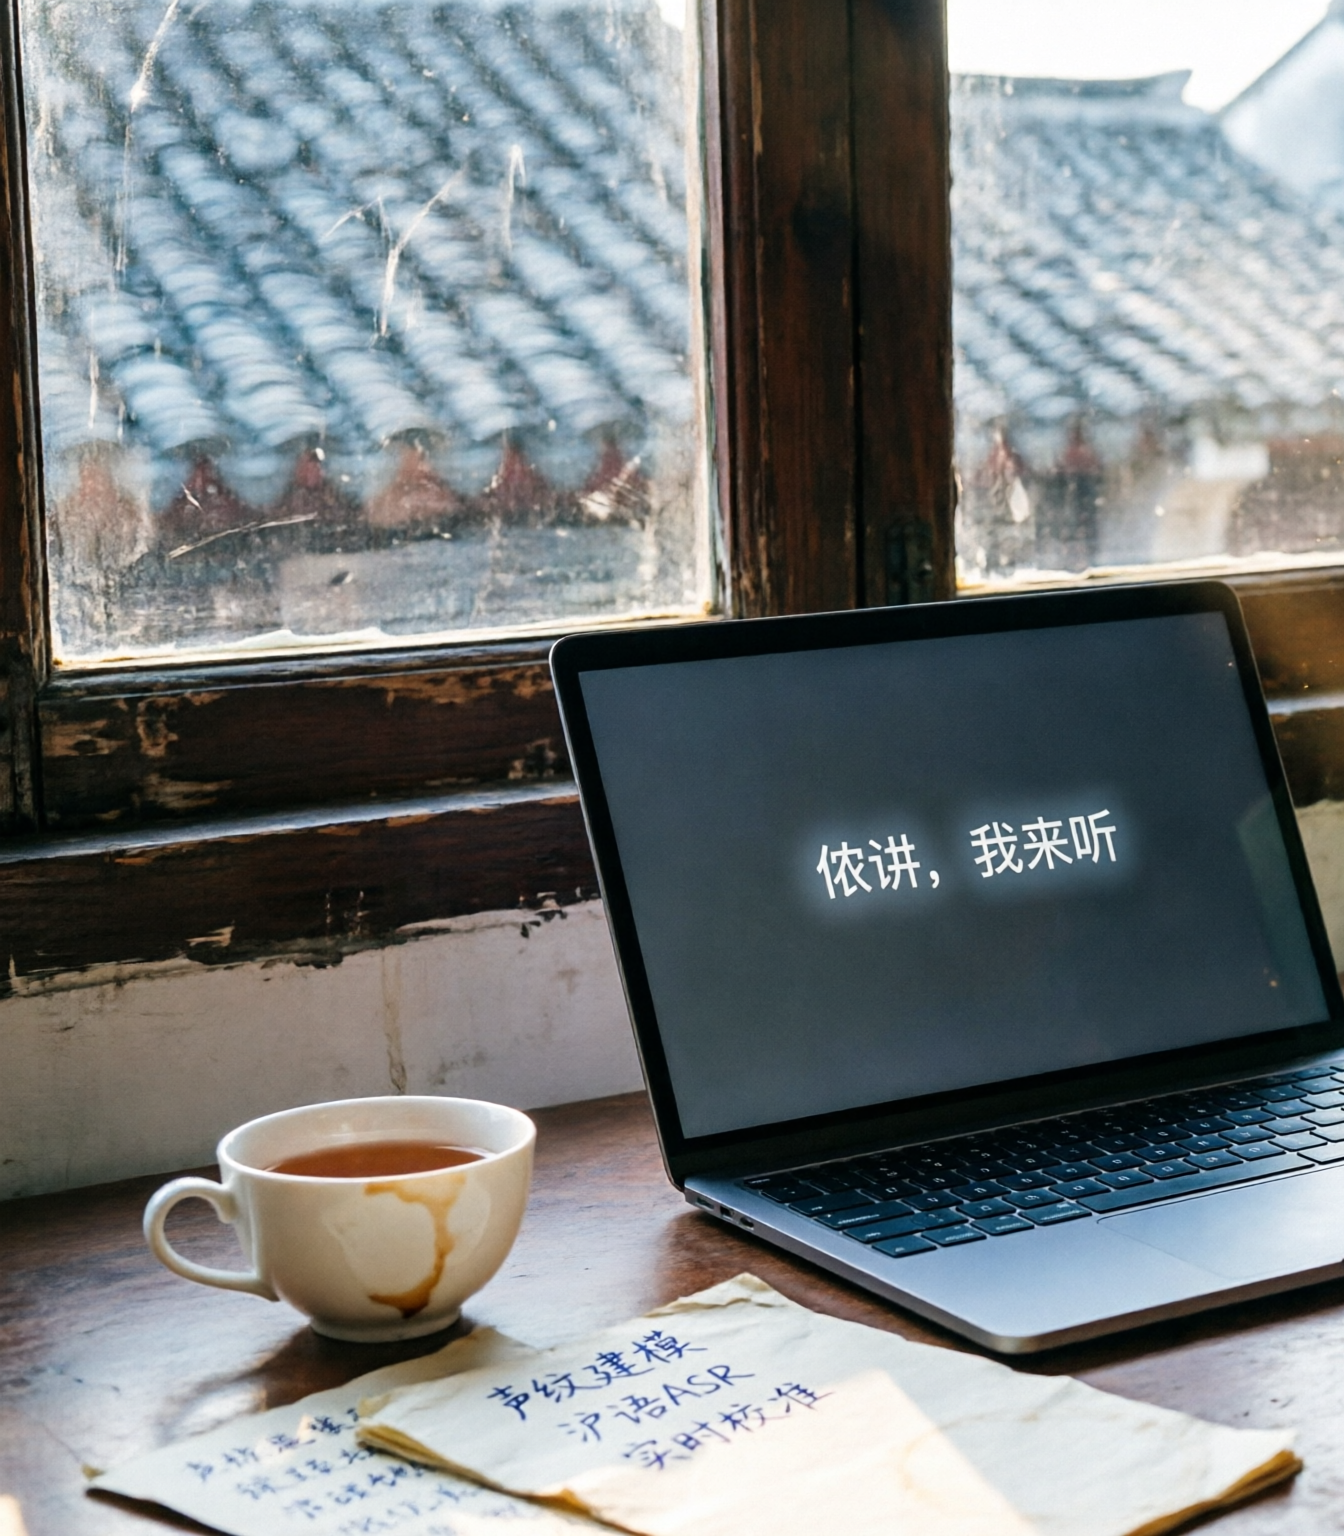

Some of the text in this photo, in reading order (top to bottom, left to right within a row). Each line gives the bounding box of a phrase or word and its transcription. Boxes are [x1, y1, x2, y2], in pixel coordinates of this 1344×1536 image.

[486, 1329, 708, 1421] 声纹建模
[557, 1364, 755, 1442] 沪语ASR
